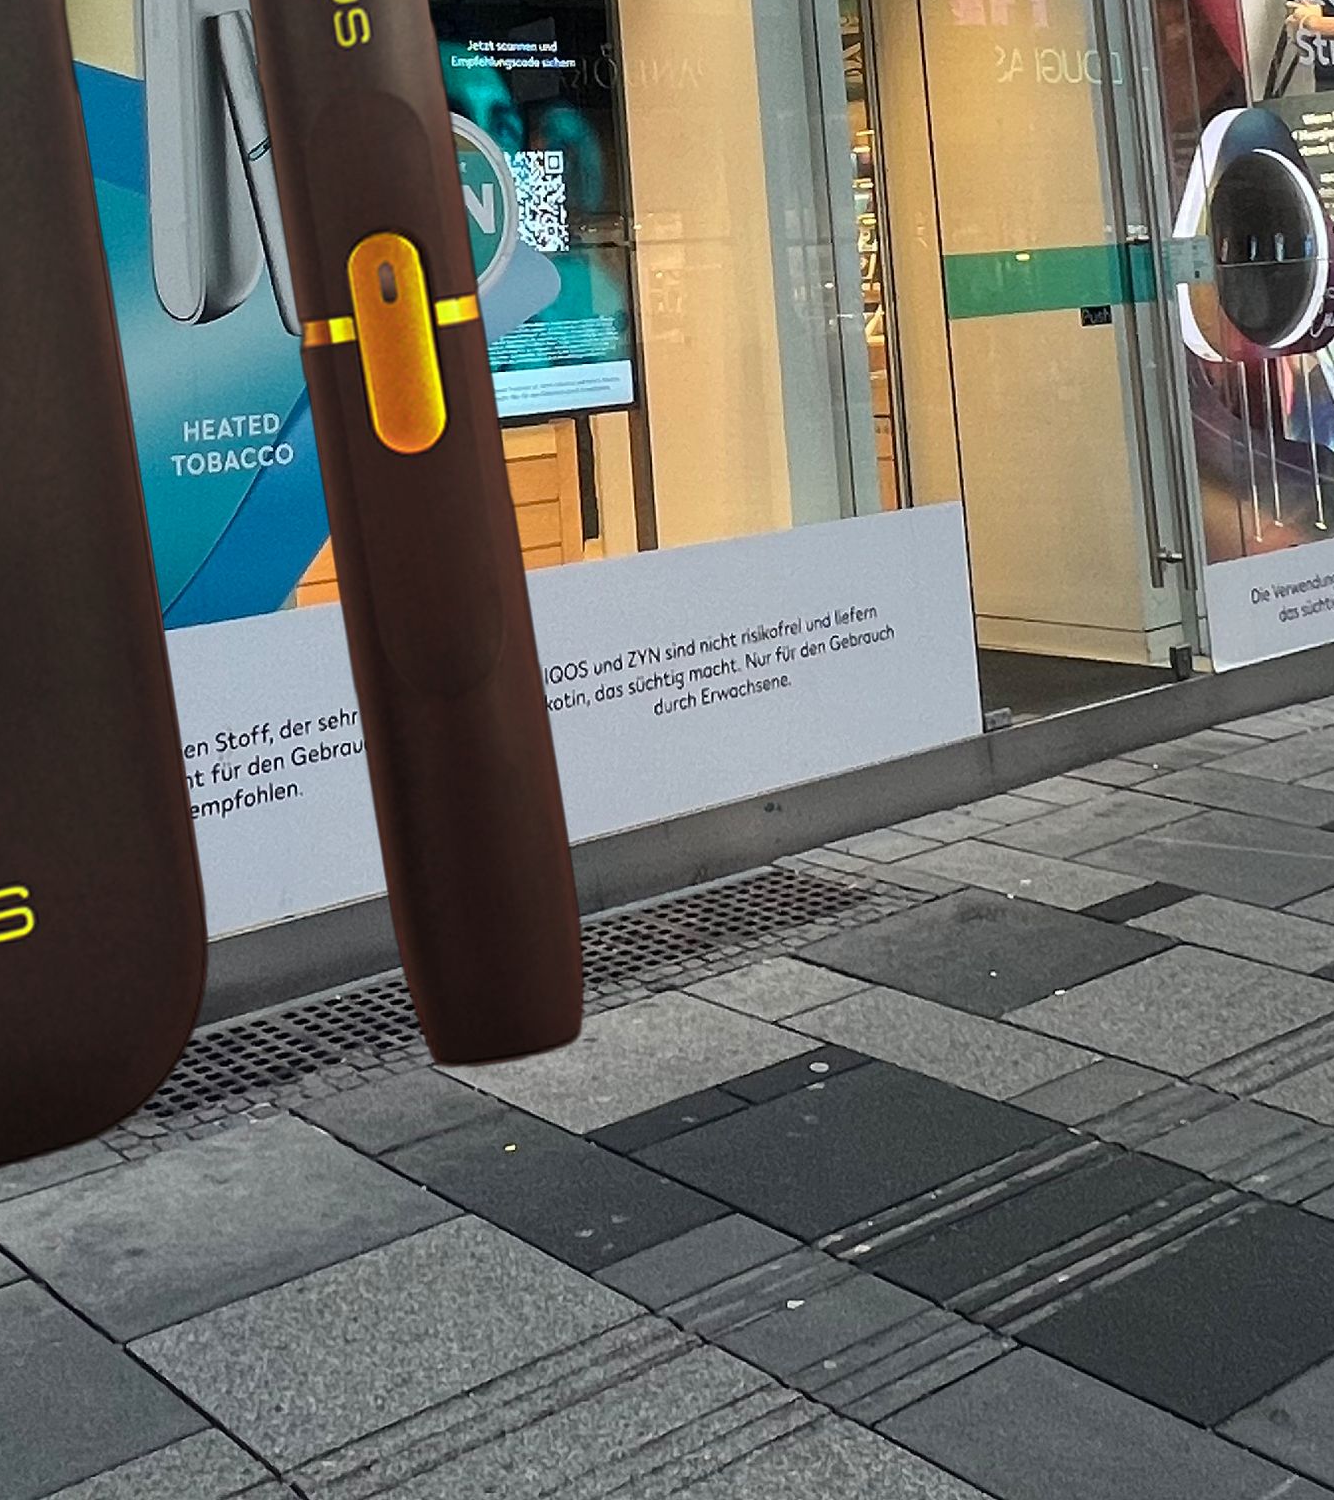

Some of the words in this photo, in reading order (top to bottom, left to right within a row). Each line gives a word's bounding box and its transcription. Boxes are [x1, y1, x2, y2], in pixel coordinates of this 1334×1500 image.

[539, 40, 558, 52] und
[183, 412, 280, 443] HEATED
[170, 442, 295, 477] TOBACCO
[543, 660, 589, 686] IQOS
[593, 653, 624, 676] und
[627, 646, 661, 669] ZYN
[664, 638, 696, 660] sind
[699, 632, 737, 654] nicht
[806, 611, 832, 633] und
[834, 605, 878, 626] liefern
[544, 688, 592, 712] kotin,
[594, 683, 624, 703] das
[628, 669, 685, 691] süchtig
[689, 657, 742, 683] macht.
[745, 651, 771, 671] Nur
[774, 645, 797, 664] für
[800, 640, 827, 659] den
[829, 624, 896, 652] Gebrauch
[653, 692, 697, 716] durch
[700, 673, 792, 706] Erwachsene.
[215, 722, 275, 753] Stoff,
[279, 718, 312, 741] der
[318, 707, 359, 733] sehr
[211, 762, 242, 784] für
[247, 754, 285, 777] den
[291, 739, 367, 767] Gebrau
[190, 781, 305, 820] empfohlen.
